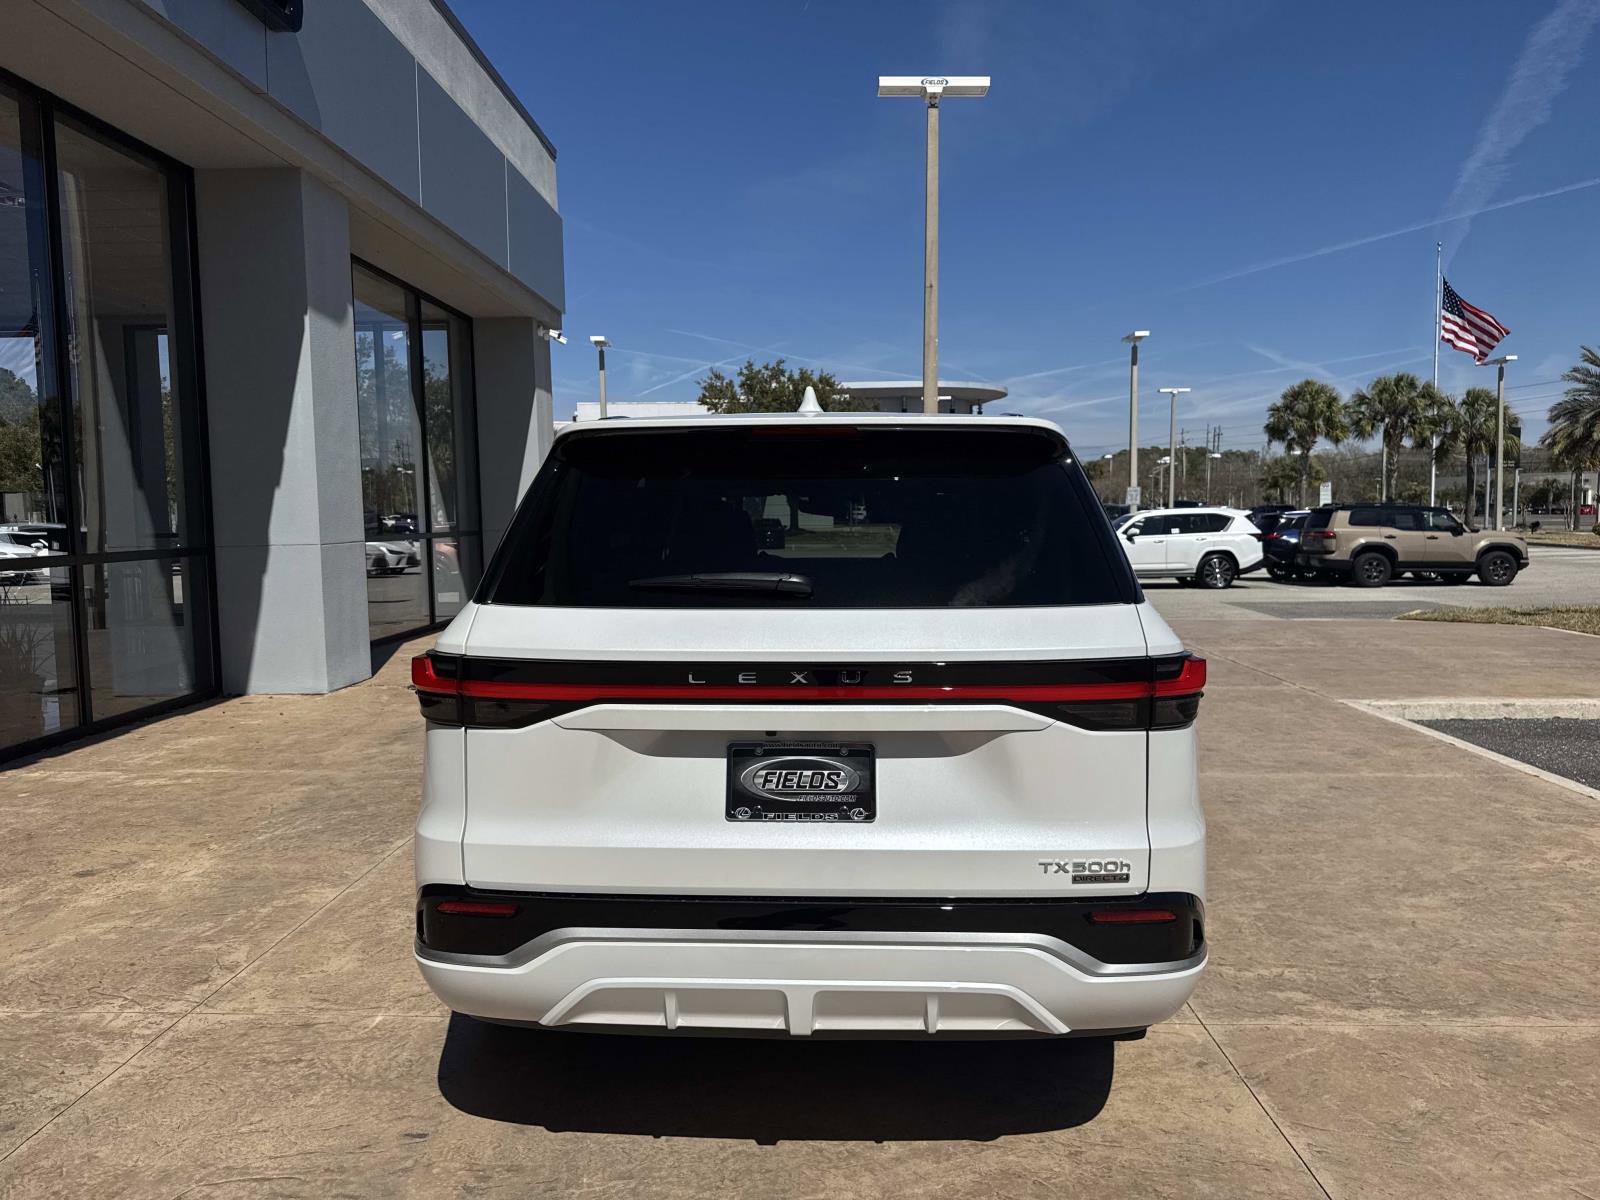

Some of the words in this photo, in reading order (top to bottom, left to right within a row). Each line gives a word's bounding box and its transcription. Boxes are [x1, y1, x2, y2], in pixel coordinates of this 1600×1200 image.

[924, 78, 945, 86] FIELDS
[687, 671, 913, 684] LEXUS
[761, 771, 841, 790] FIELDS
[762, 812, 838, 821] FIELDS
